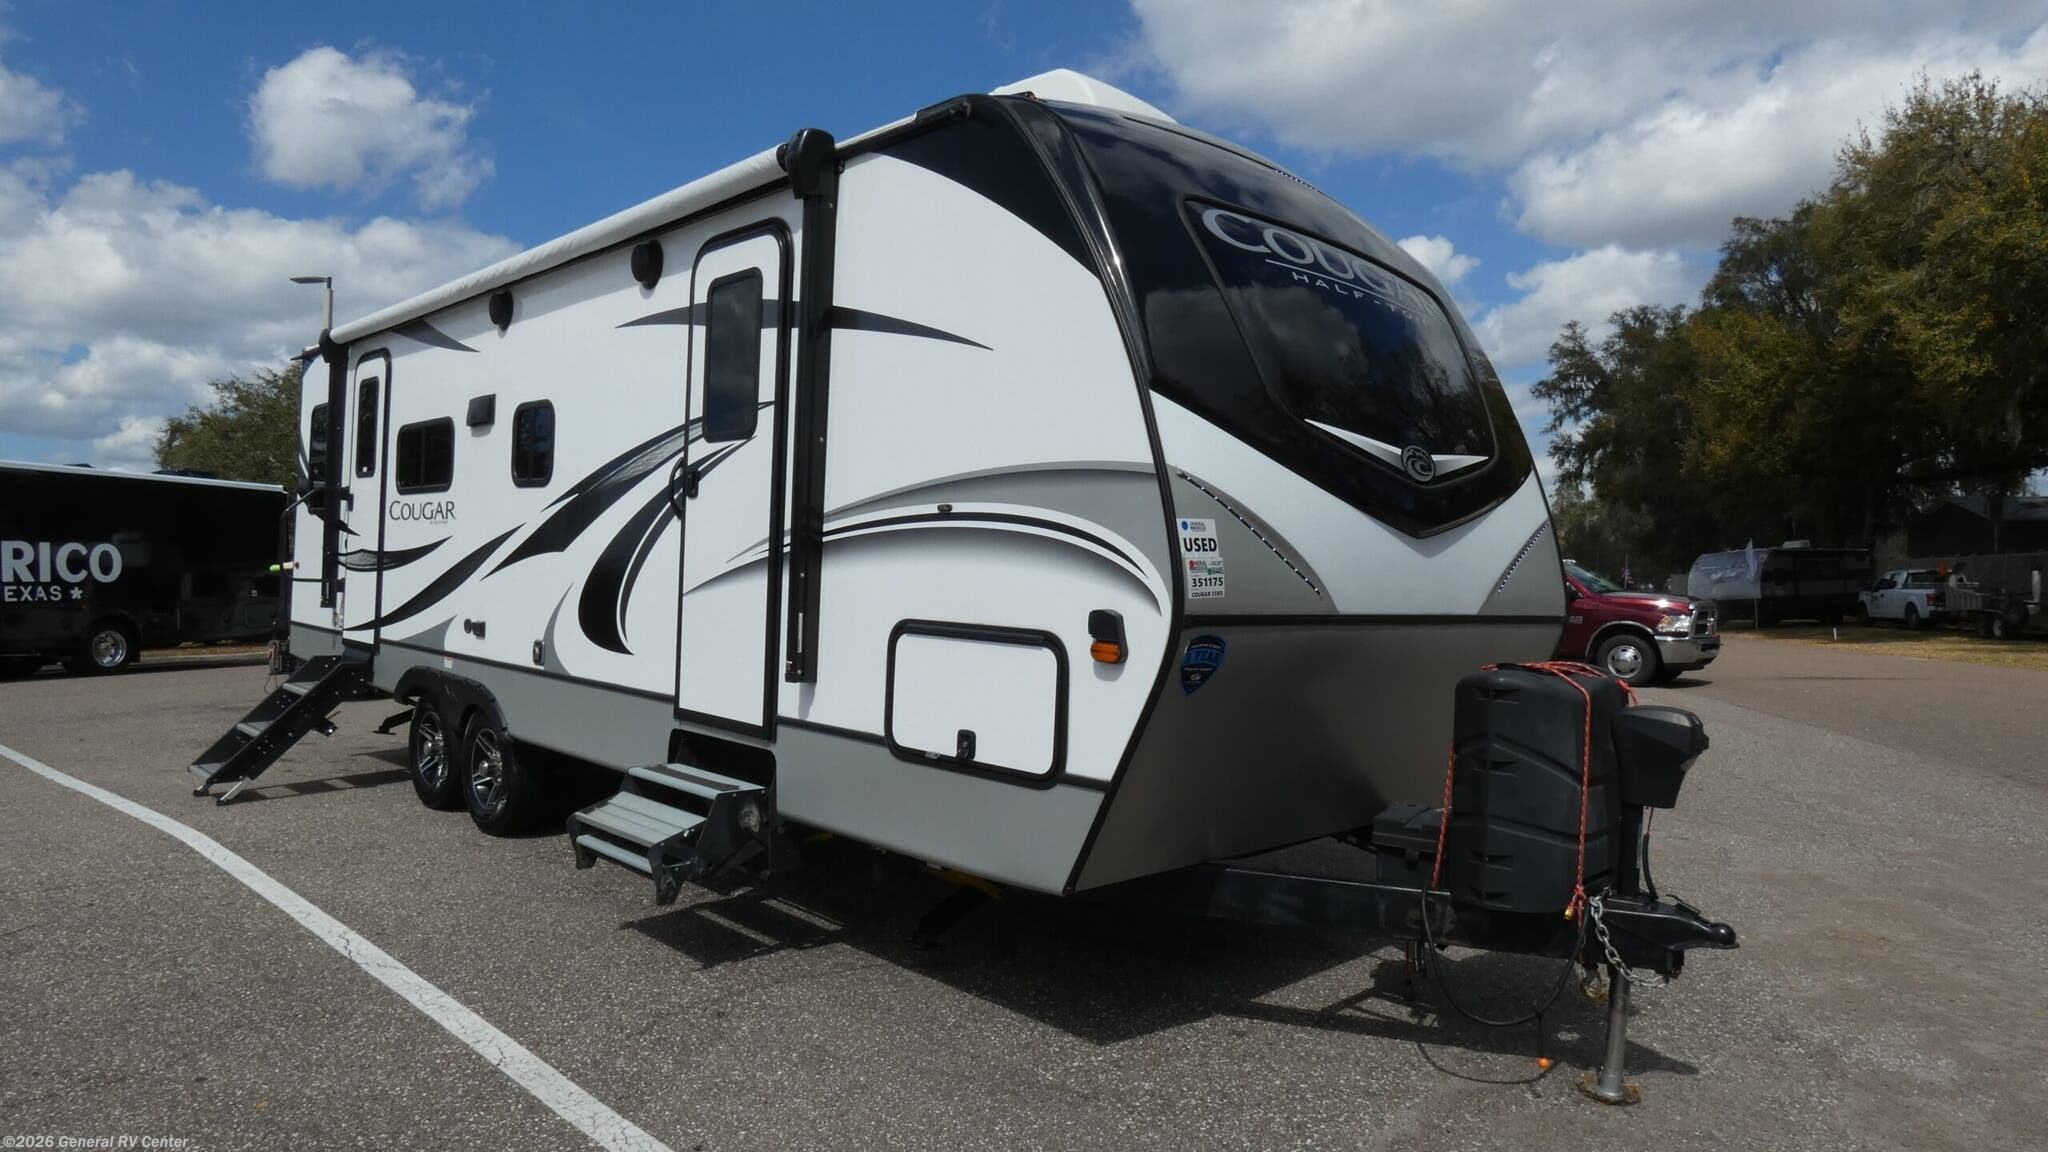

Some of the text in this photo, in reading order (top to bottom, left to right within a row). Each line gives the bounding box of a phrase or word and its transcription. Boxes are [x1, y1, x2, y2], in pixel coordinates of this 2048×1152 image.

[389, 500, 456, 521] COUGAR
[1183, 538, 1217, 552] USED
[1, 540, 123, 583] RICO
[1191, 577, 1223, 588] 351175
[4, 585, 62, 602] EXAS
